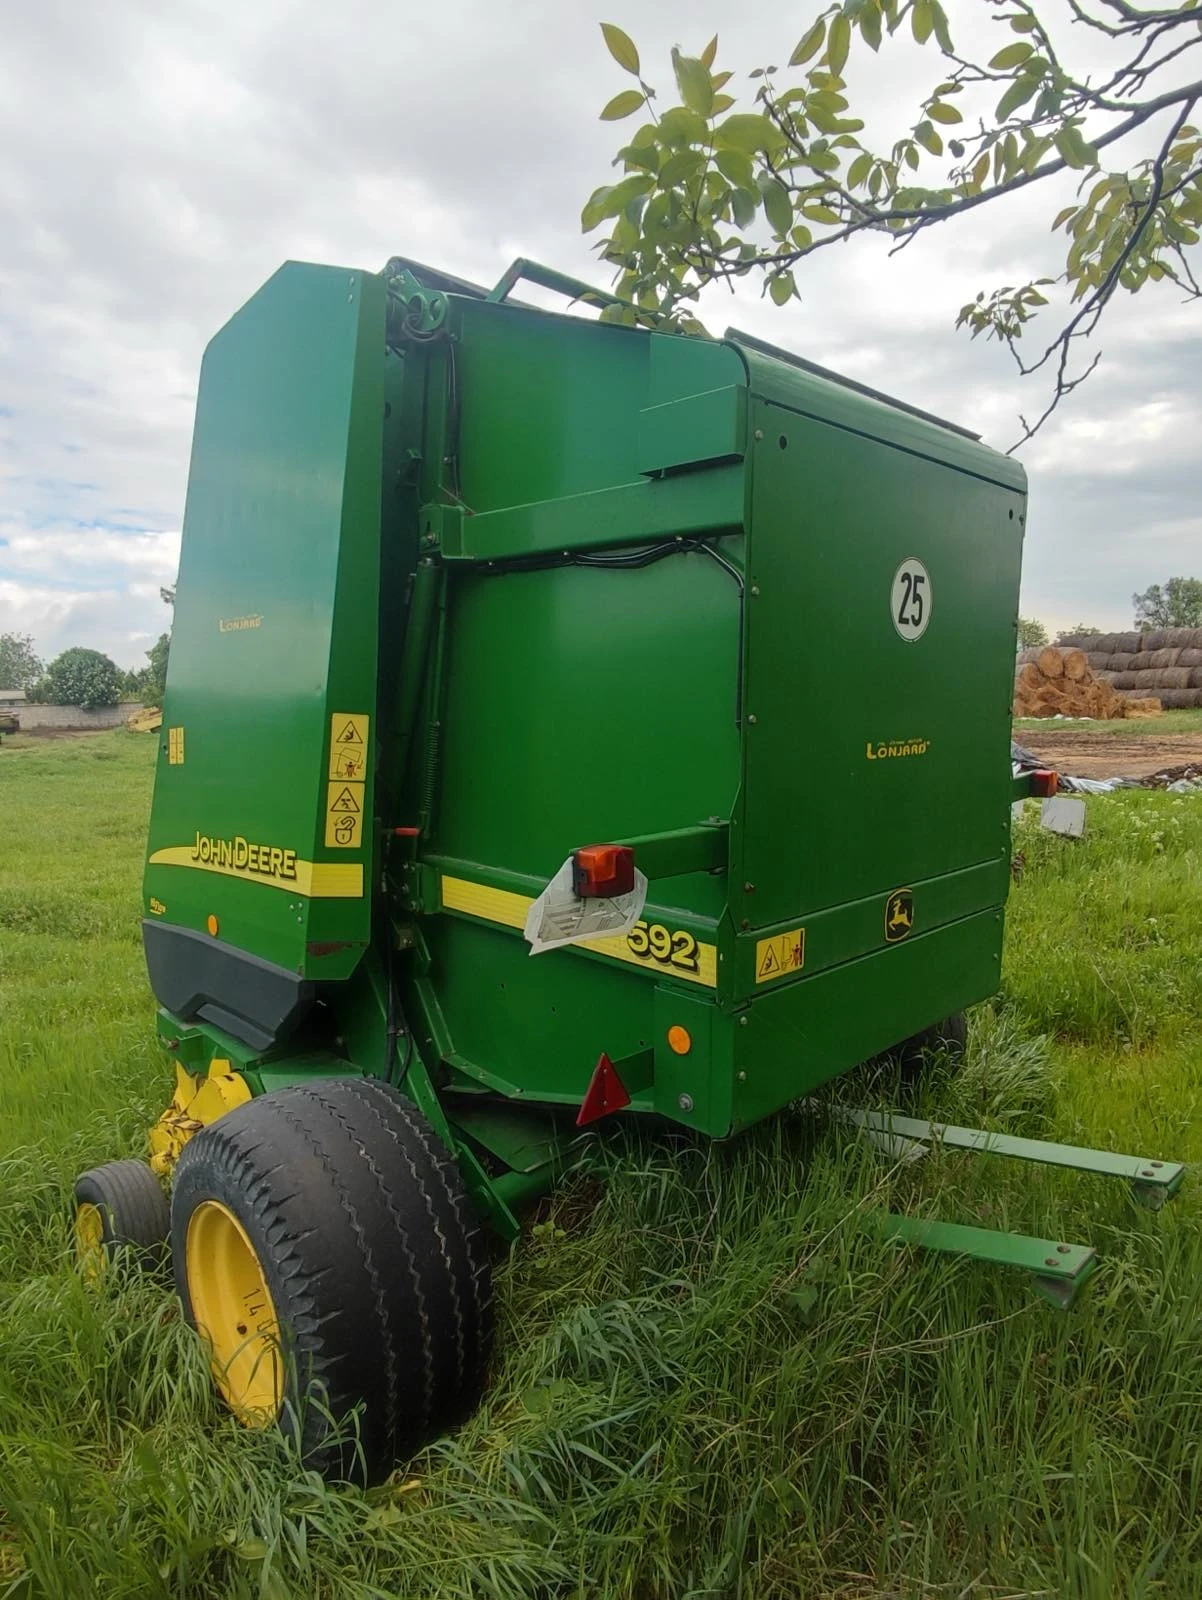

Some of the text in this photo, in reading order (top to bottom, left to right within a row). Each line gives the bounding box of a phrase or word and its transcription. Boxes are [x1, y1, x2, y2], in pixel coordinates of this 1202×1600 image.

[898, 572, 925, 627] 25
[192, 831, 297, 880] JOHN DEERE
[626, 921, 700, 976] 592
